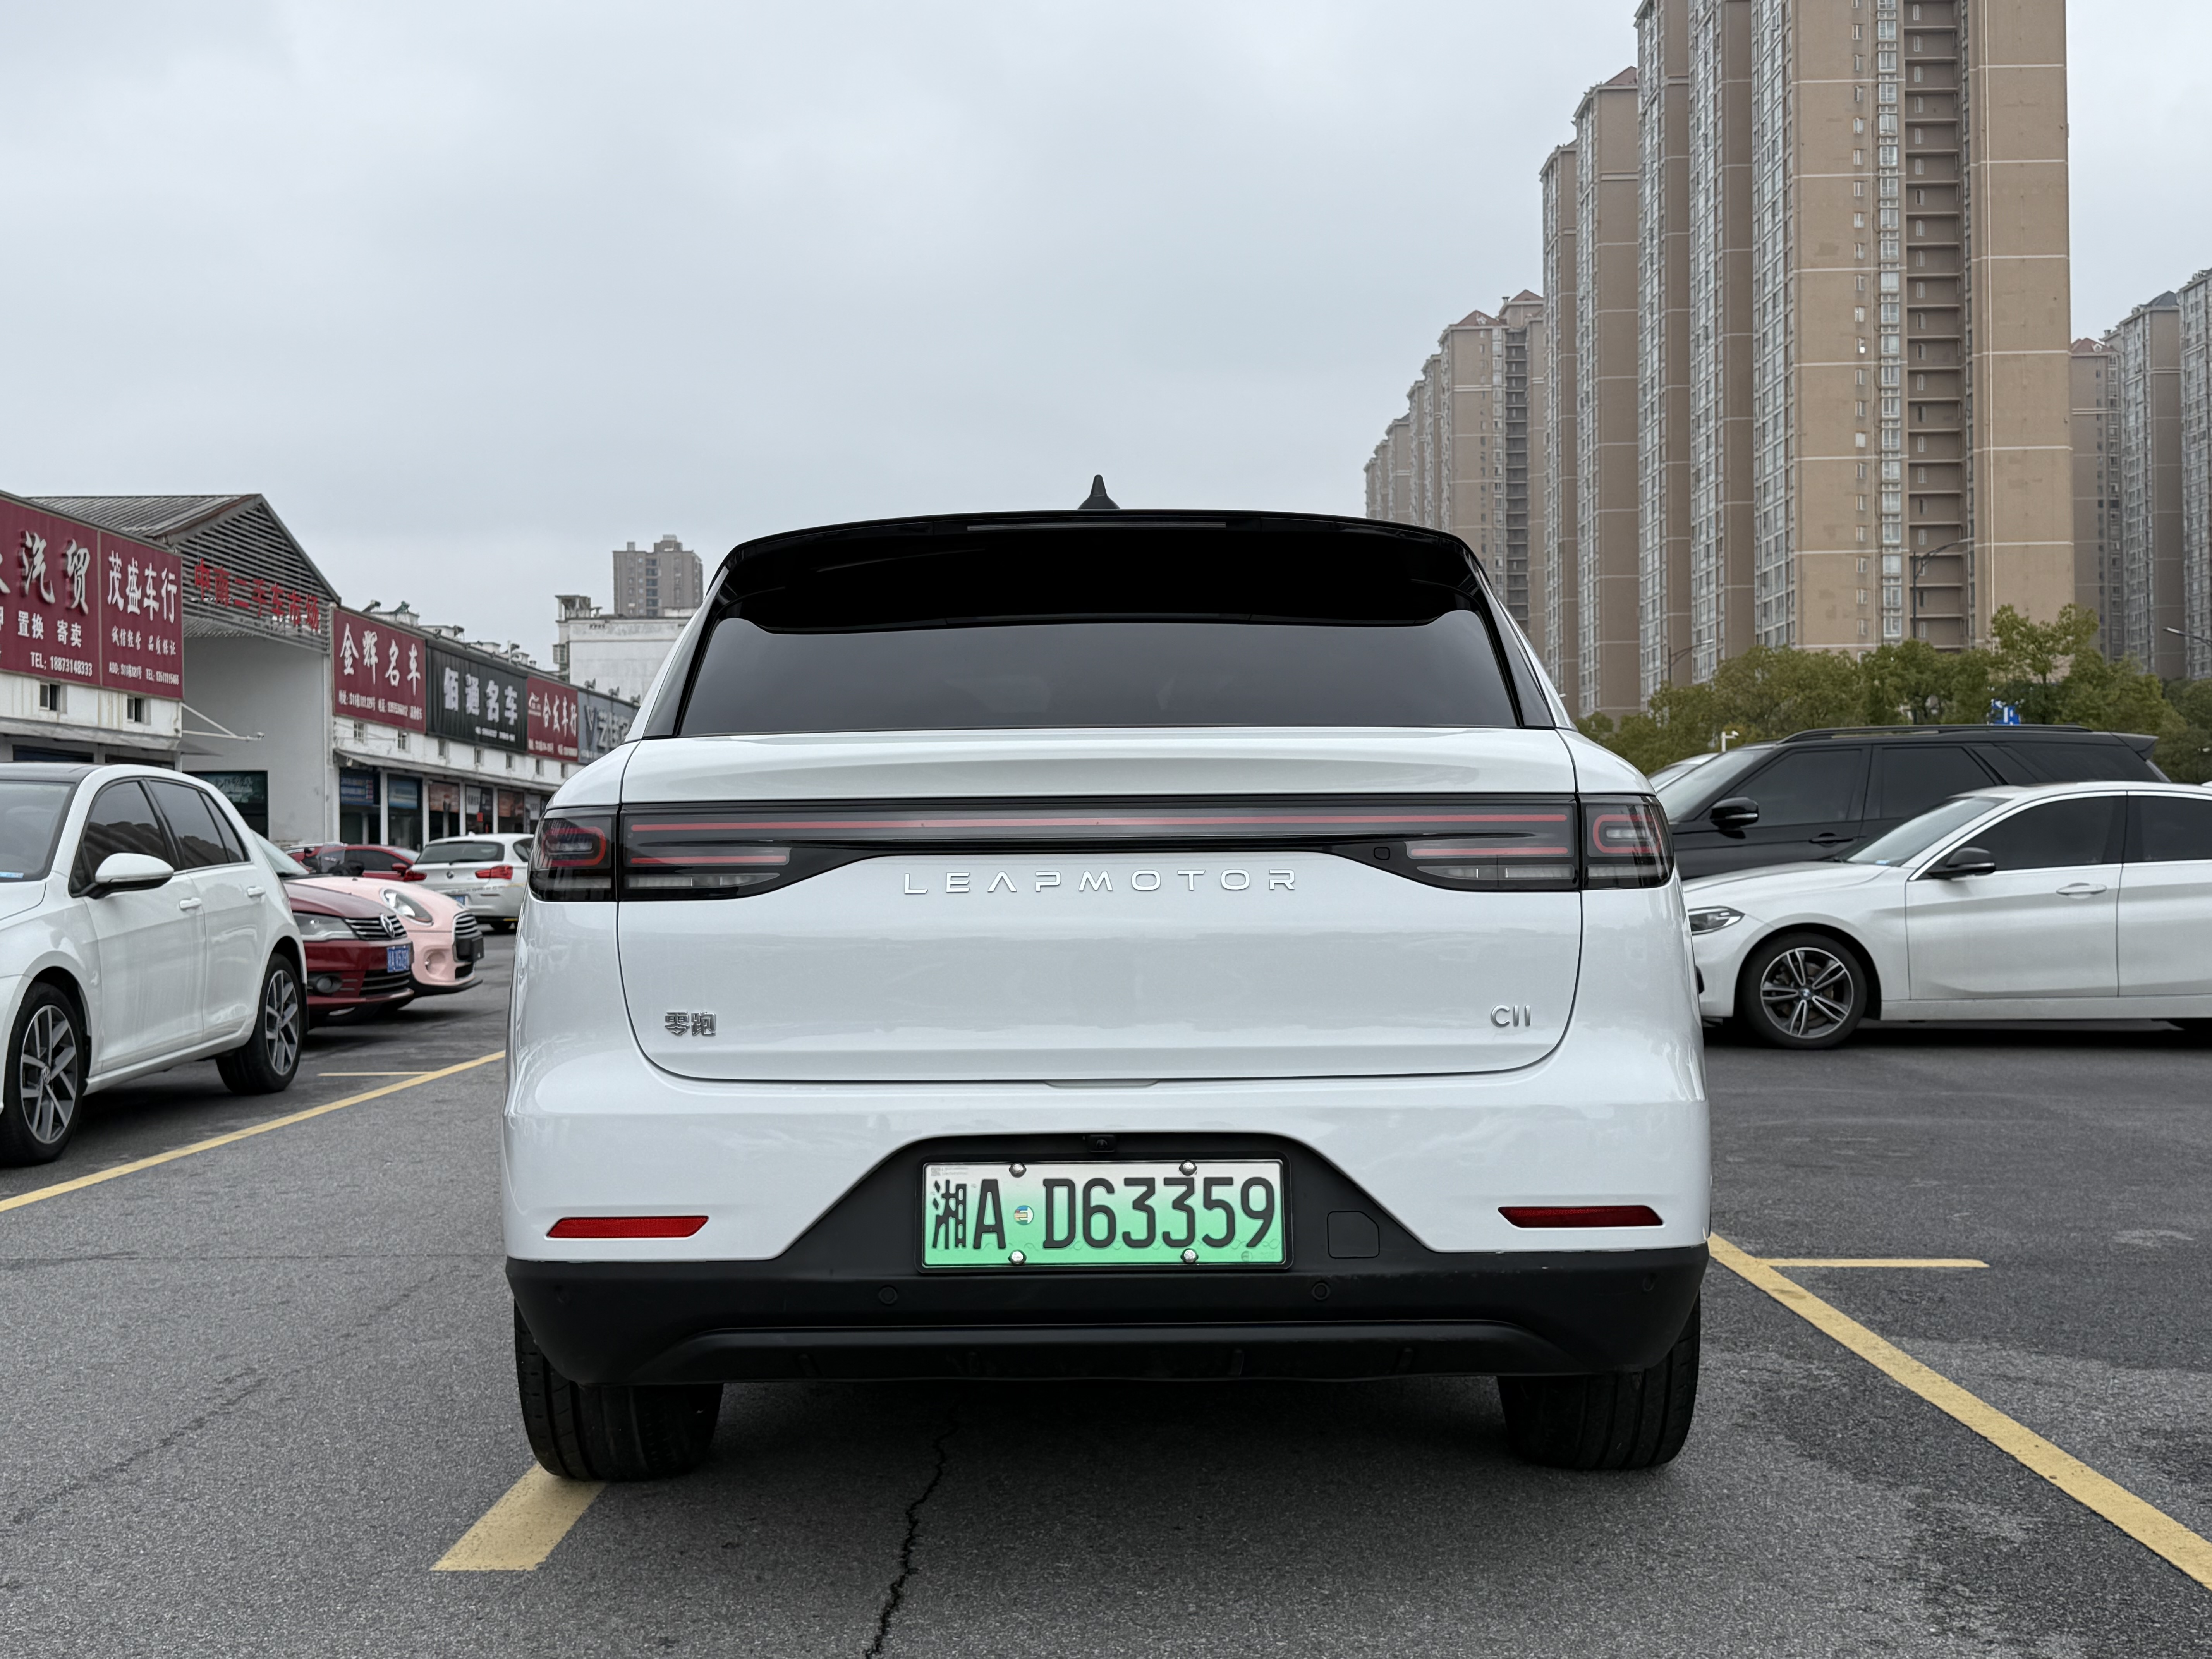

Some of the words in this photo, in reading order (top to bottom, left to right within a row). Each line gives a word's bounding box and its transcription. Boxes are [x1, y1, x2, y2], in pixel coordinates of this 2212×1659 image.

[107, 550, 177, 624] 茂盛车行
[17, 610, 44, 640] 置换
[57, 619, 82, 648] 寄卖
[903, 869, 1296, 894] LEAPMOTOR
[664, 1012, 716, 1037] 零跑
[1043, 1176, 1274, 1249] D63359
